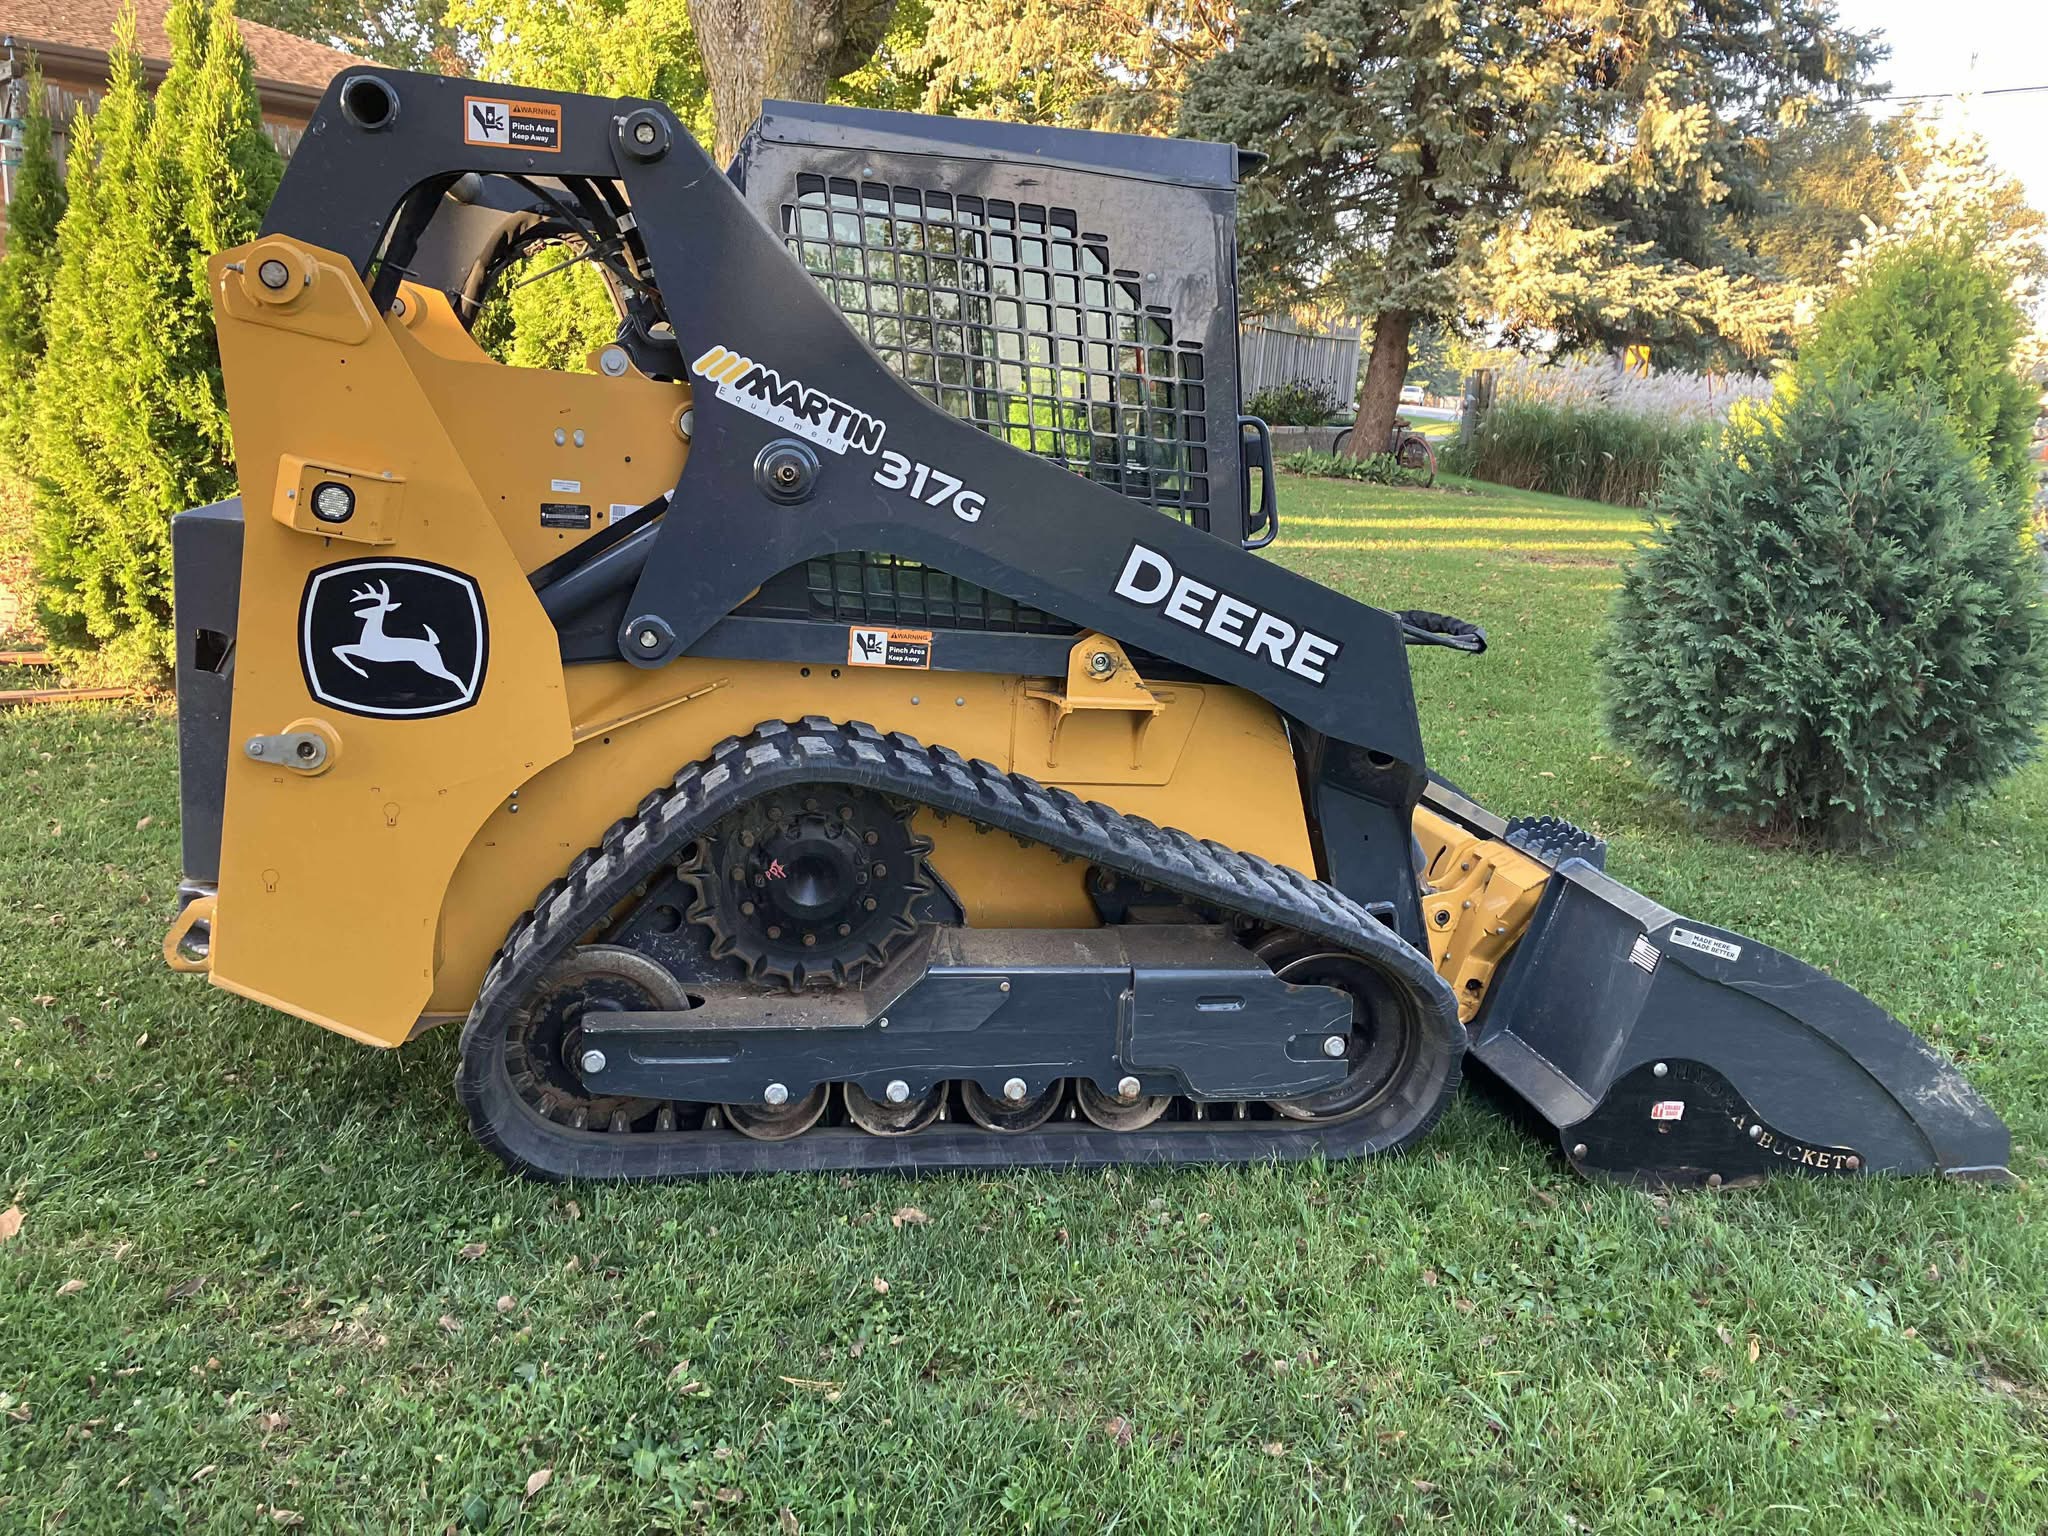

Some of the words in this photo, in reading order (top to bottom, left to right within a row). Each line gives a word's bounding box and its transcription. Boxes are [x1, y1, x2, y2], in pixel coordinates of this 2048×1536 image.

[520, 107, 557, 116] WARNING
[512, 122, 535, 131] Pinch
[536, 124, 555, 133] Area
[512, 132, 530, 141] Keep
[530, 134, 549, 143] Away
[734, 366, 885, 452] MARTIN
[719, 386, 847, 451] Equipment
[873, 450, 986, 523] 317G
[1114, 544, 1339, 684] DEERE
[897, 633, 928, 641] WARNING
[889, 646, 909, 654] Pinch
[909, 647, 926, 655] Area
[903, 656, 920, 664] Away
[1691, 941, 1710, 951] MADE
[1711, 947, 1735, 958] BETTER
[1693, 935, 1712, 945] MADE
[1713, 941, 1731, 951] HERE
[1757, 1131, 1848, 1170] BUCKET
